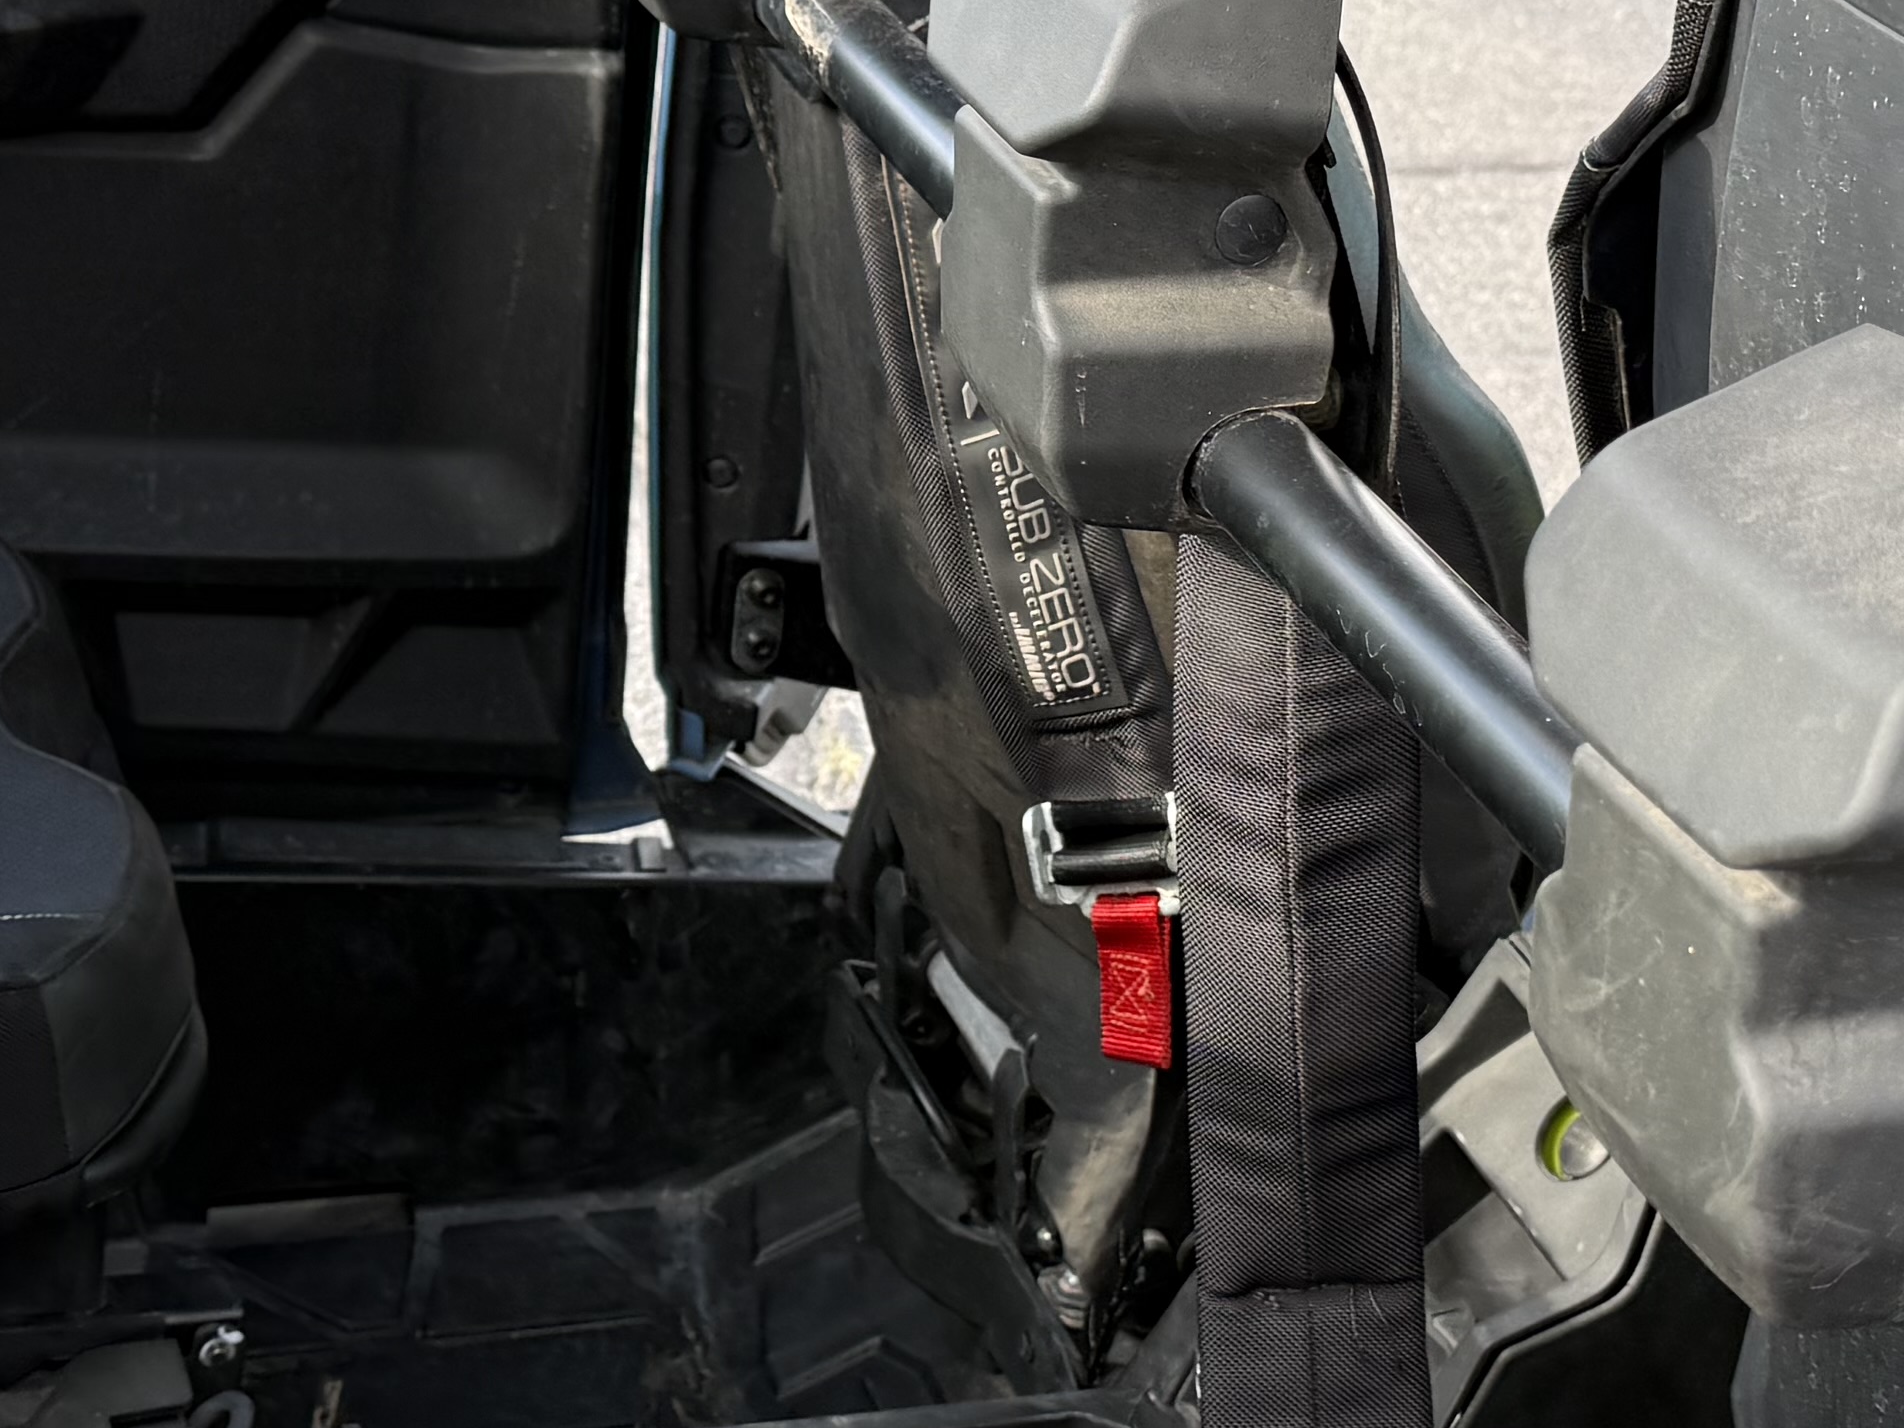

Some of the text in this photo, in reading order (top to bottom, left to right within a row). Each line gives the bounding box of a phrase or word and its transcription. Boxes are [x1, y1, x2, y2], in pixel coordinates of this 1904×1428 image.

[988, 447, 1067, 693] CONTROLLED DECELERATOR
[1030, 552, 1097, 689] ZERO
